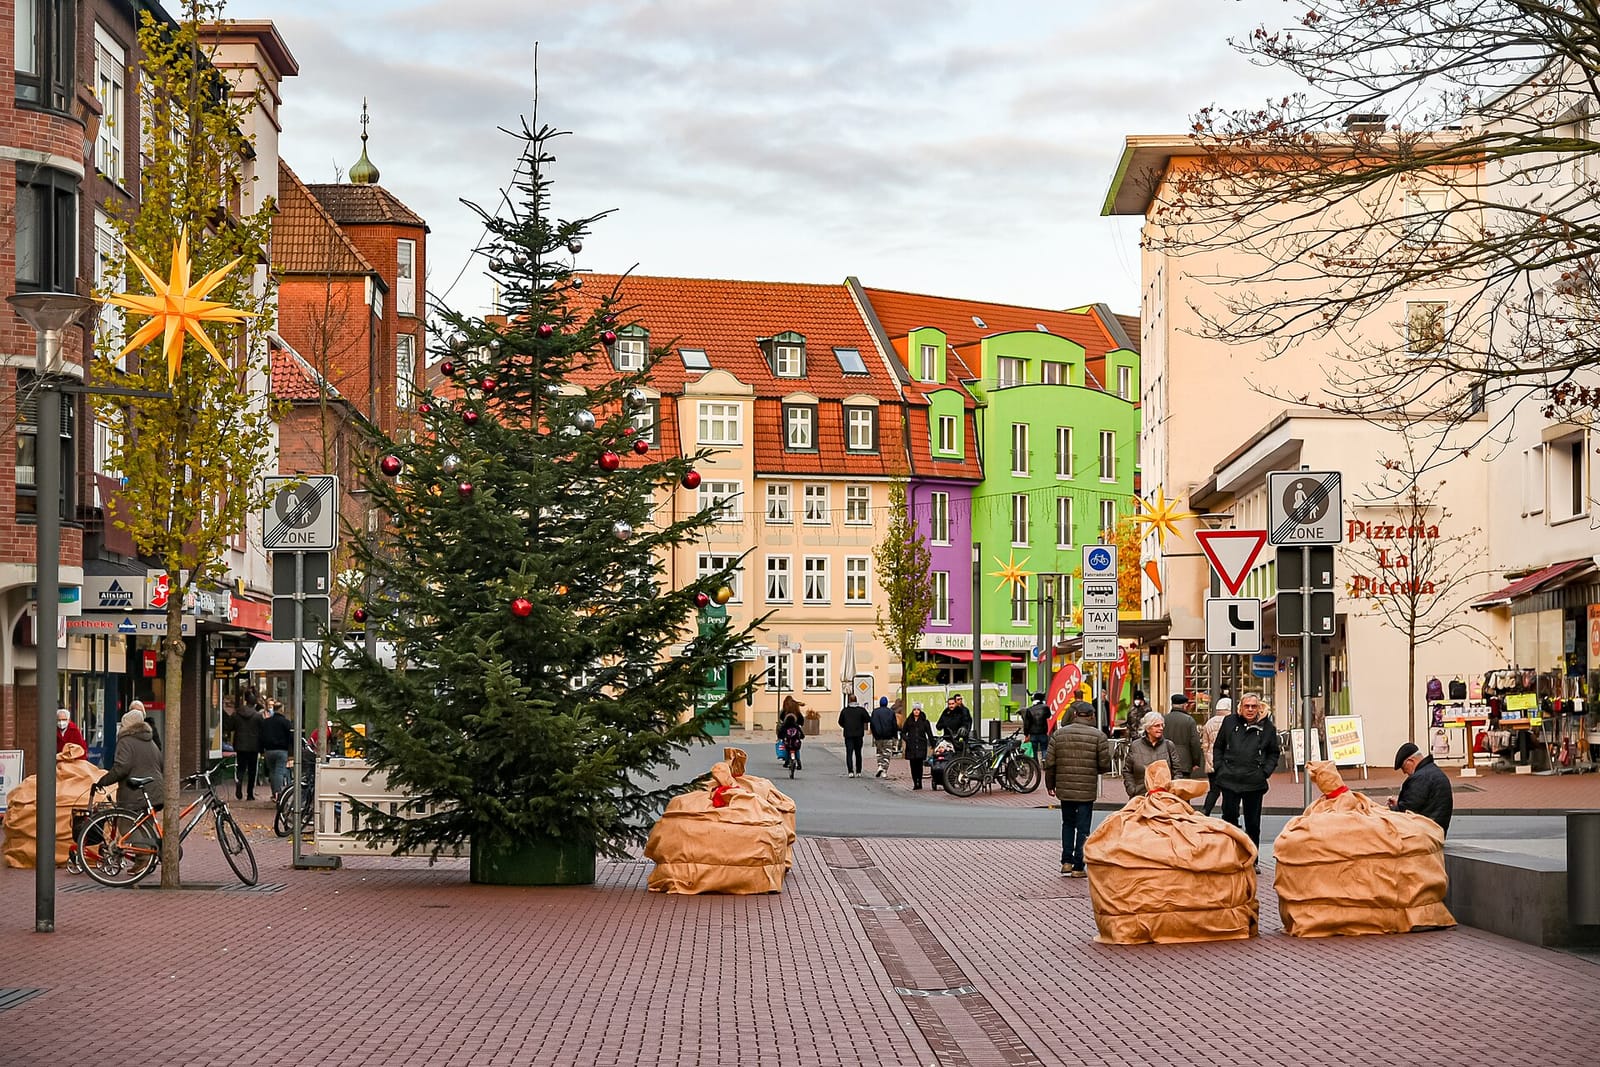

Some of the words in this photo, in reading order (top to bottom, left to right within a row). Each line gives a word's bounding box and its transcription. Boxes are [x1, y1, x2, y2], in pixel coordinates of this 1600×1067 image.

[281, 532, 315, 543] ZONE
[1290, 527, 1325, 539] ZONE
[1345, 520, 1440, 543] Pizzeria
[1376, 549, 1409, 568] La
[1095, 596, 1106, 604] frei
[1088, 612, 1113, 623] TAXI
[66, 619, 114, 630] potheke
[945, 635, 967, 647] Hotel
[983, 639, 995, 647] der
[1000, 636, 1032, 648] Persiluhr
[1047, 670, 1080, 720] KIOSK
